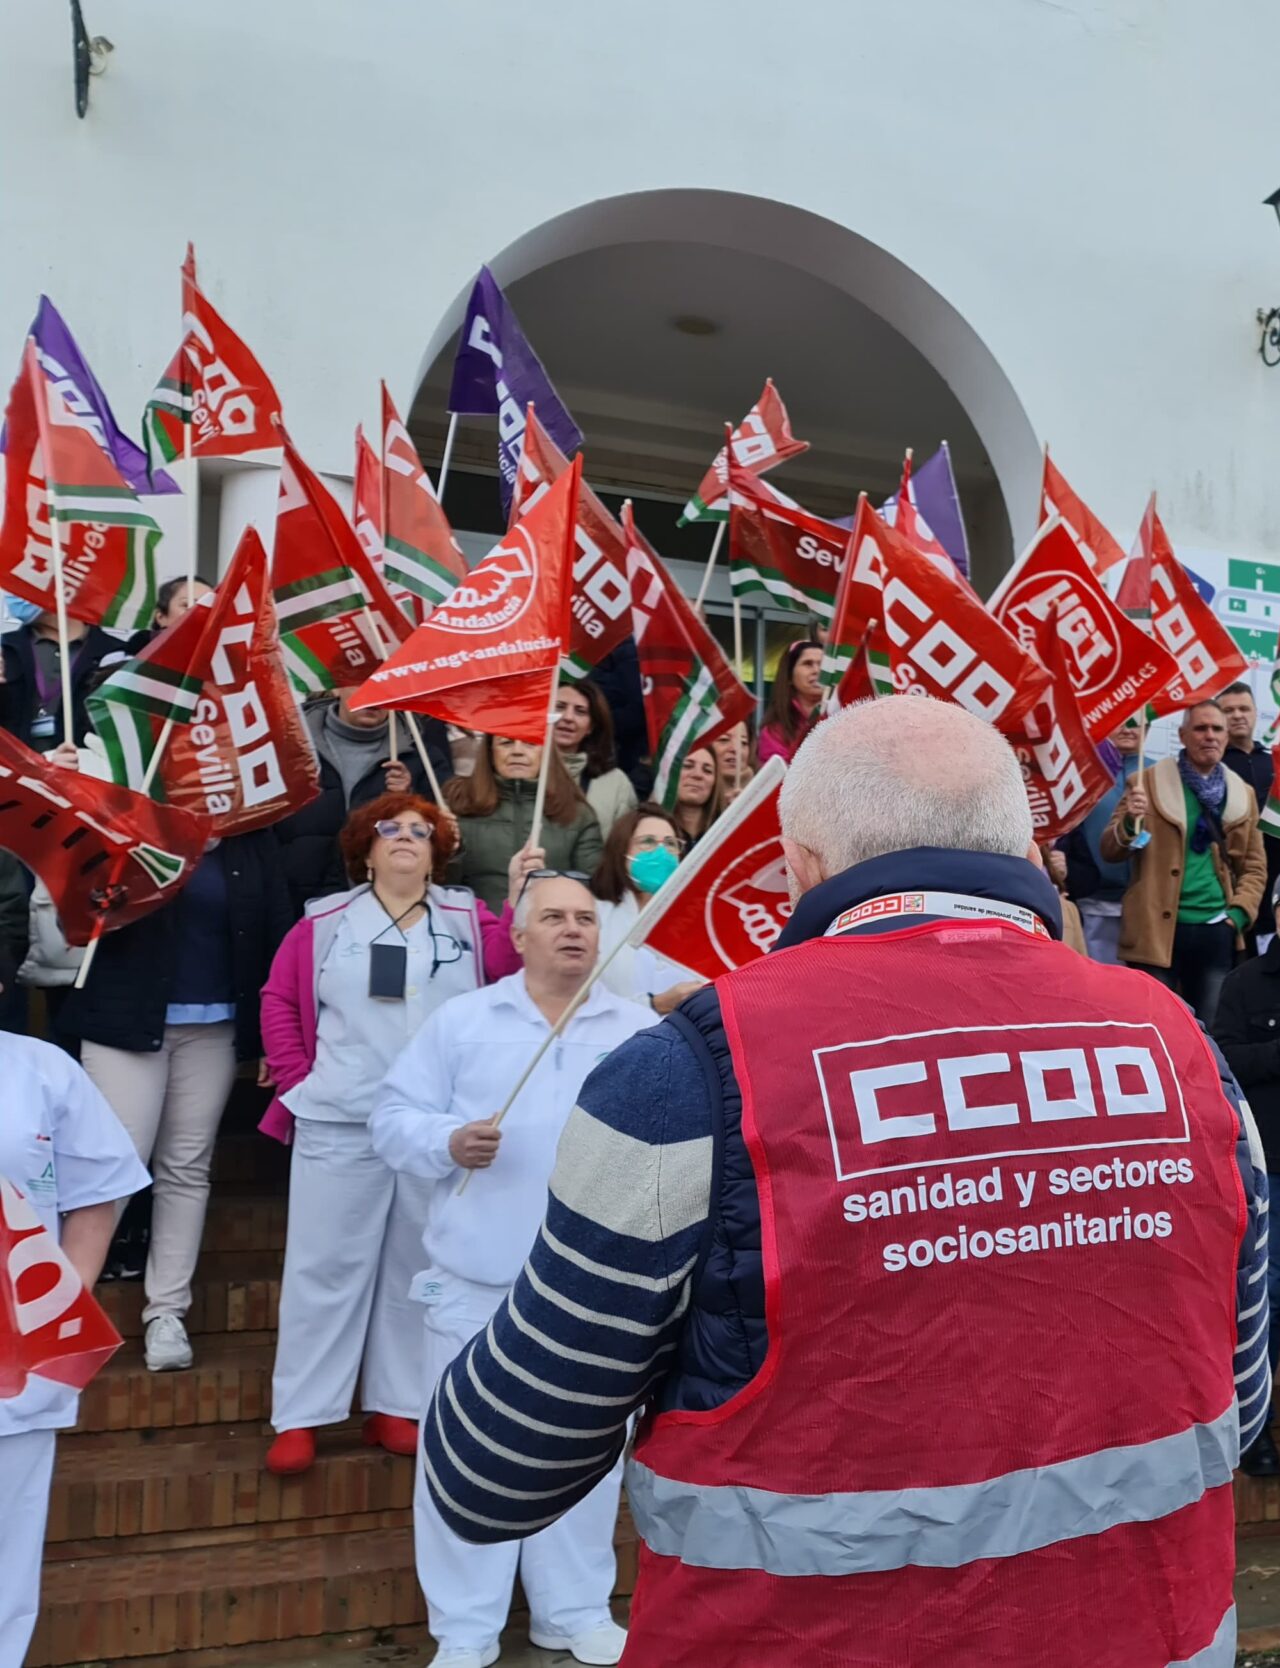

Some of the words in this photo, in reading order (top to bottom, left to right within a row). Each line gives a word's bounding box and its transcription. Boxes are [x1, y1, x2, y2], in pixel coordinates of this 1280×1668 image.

[1026, 578, 1115, 673] UGT
[190, 698, 236, 815] Sevilla
[850, 898, 899, 920] CCOO
[849, 1046, 1167, 1145] CCOO
[842, 1166, 1003, 1223] sanidad
[1013, 1169, 1037, 1208] y
[1048, 1157, 1194, 1196] sectores
[882, 1207, 1173, 1273] sociosanitarios
